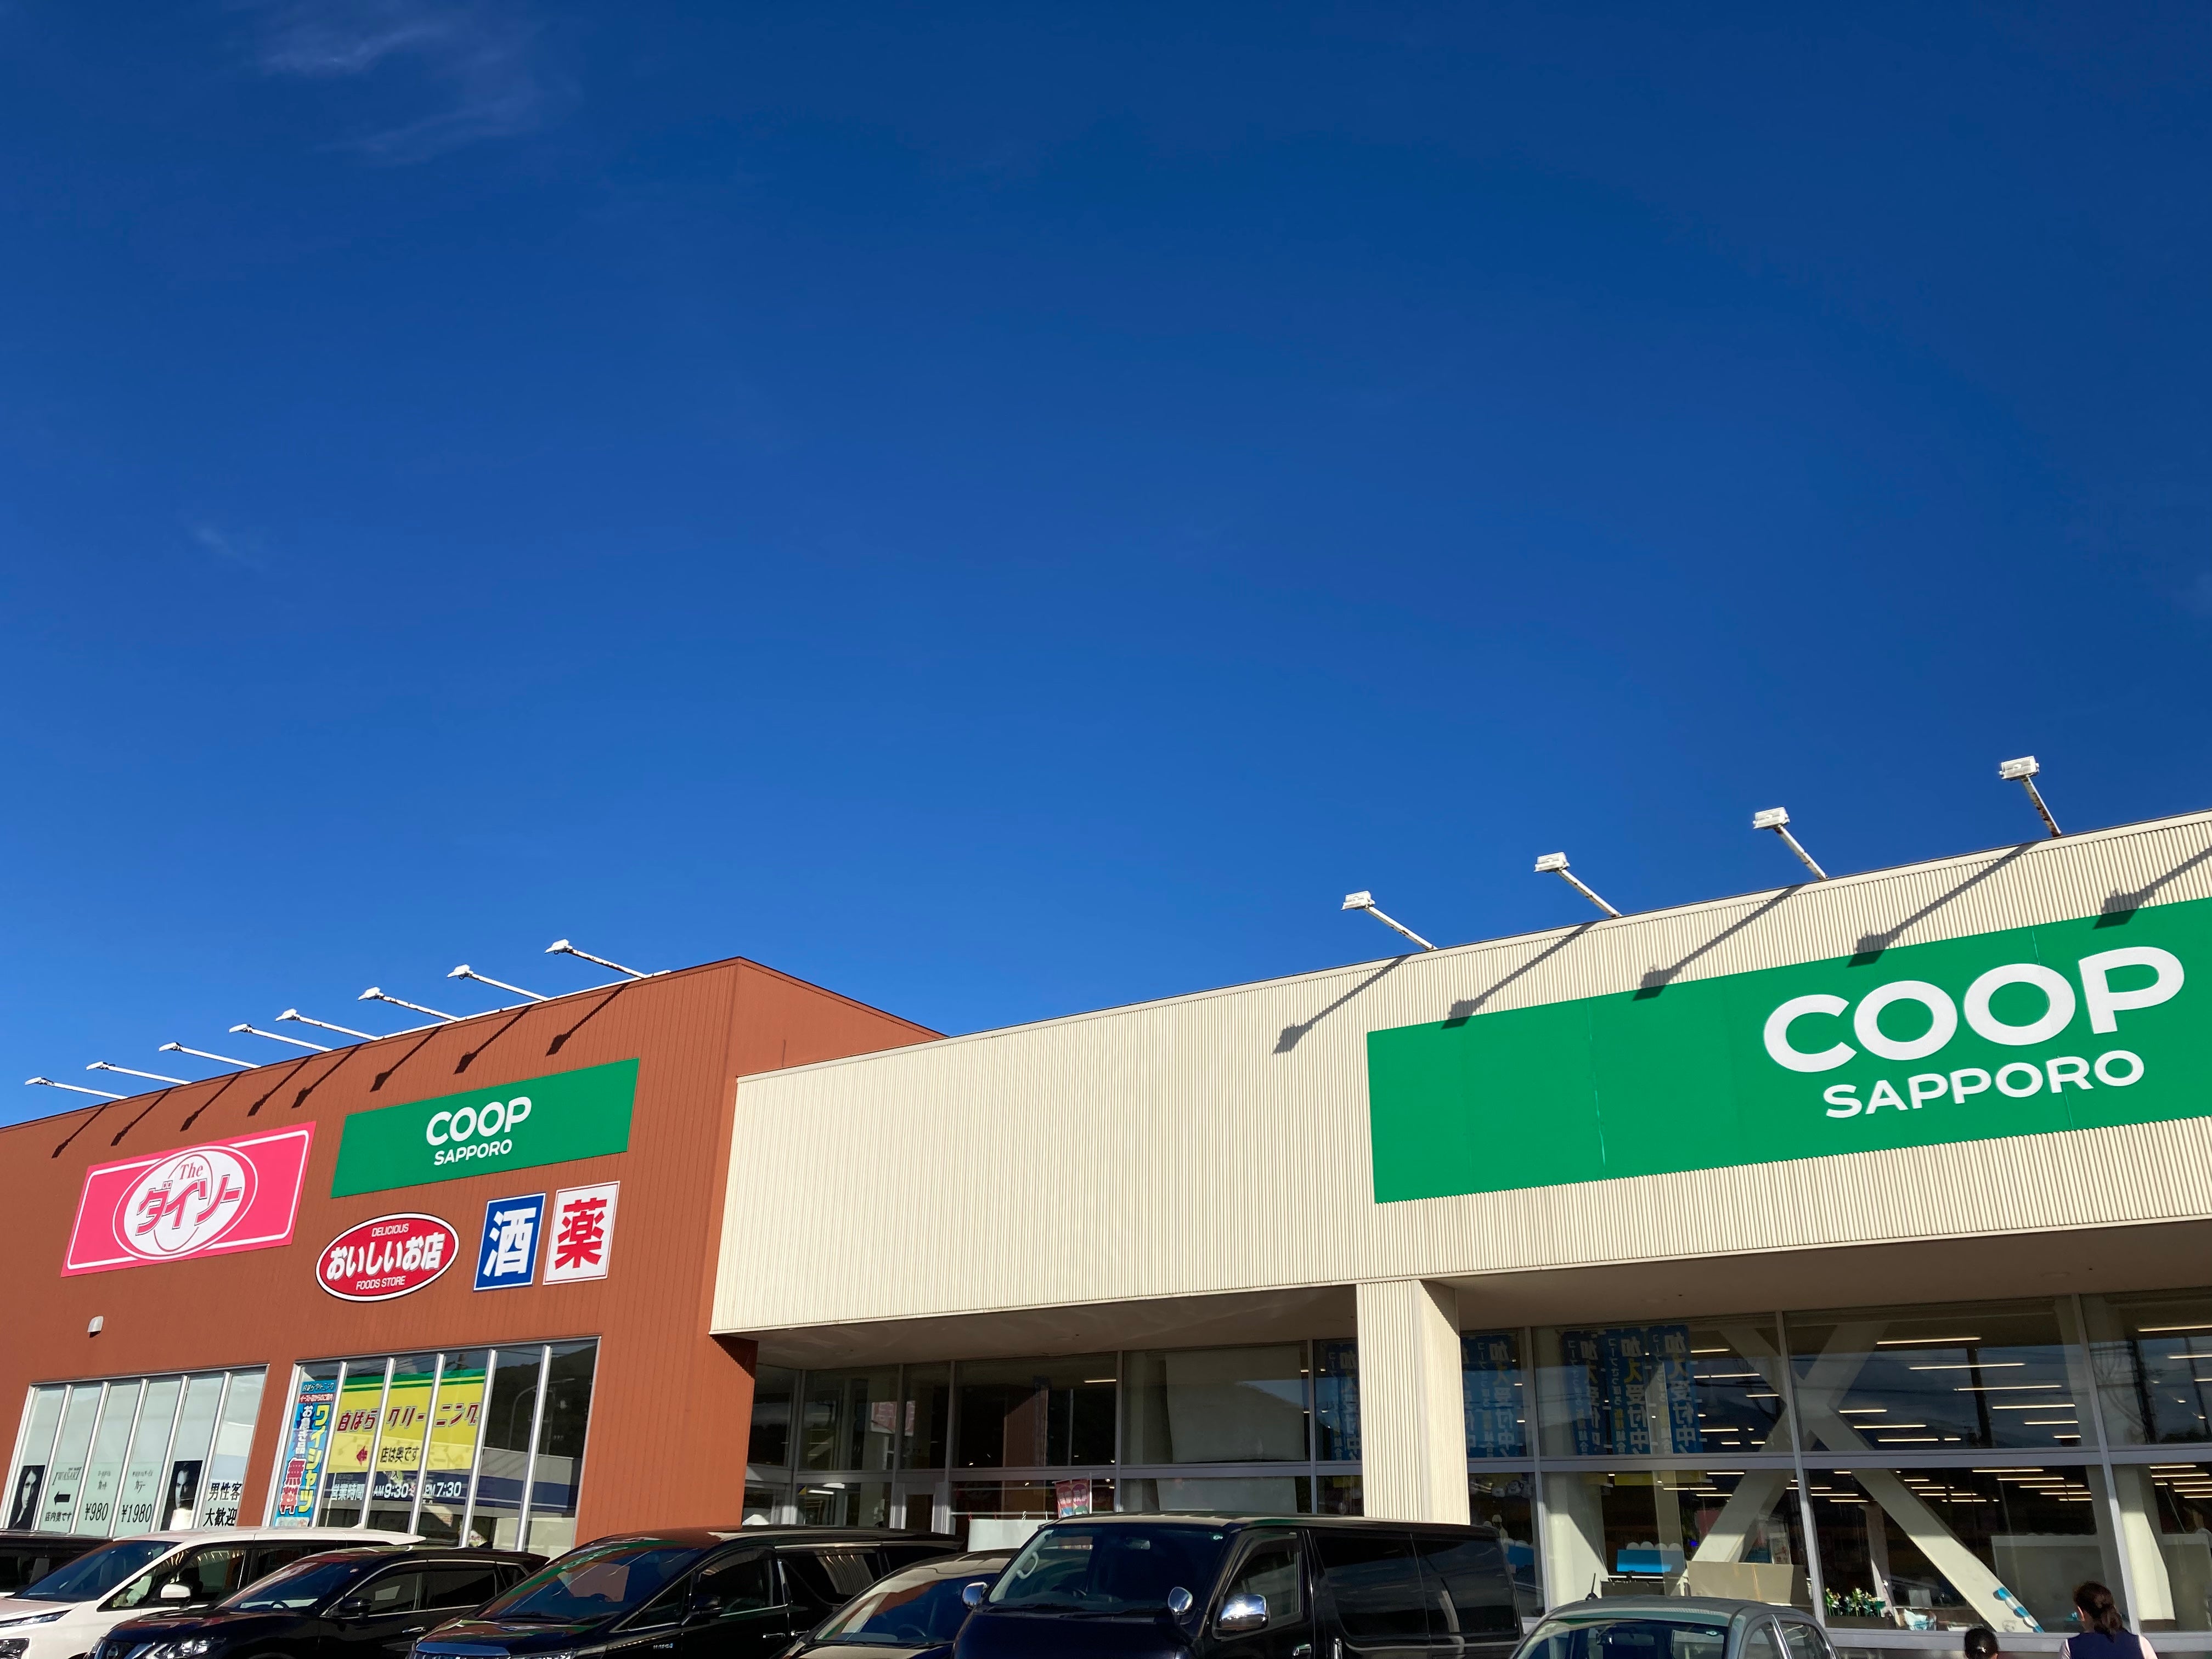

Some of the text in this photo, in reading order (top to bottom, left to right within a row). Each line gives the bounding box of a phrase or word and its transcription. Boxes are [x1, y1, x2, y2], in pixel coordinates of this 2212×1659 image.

[1764, 946, 2185, 1073] COOP
[1823, 1050, 2145, 1119] SAPPORO
[426, 1096, 532, 1147] COOP
[433, 1139, 513, 1166] SAPPORO
[178, 1161, 204, 1181] The
[135, 1173, 242, 1236] ダイソー
[371, 1223, 409, 1238] DELICIOUS
[554, 1197, 608, 1269] 薬
[482, 1206, 537, 1277] 酒
[326, 1232, 446, 1281] おいしいお店
[356, 1275, 407, 1291] FOODS STORE
[298, 1404, 331, 1513] ワイシャツ
[380, 1446, 420, 1463] 店は奥です
[207, 1481, 242, 1502] 男性客
[330, 1483, 365, 1502] 営業時間
[44, 1511, 73, 1522] 店内奥です
[84, 1502, 109, 1522] ¥980
[121, 1503, 153, 1523] ¥1980
[202, 1506, 239, 1527] 大歓迎
